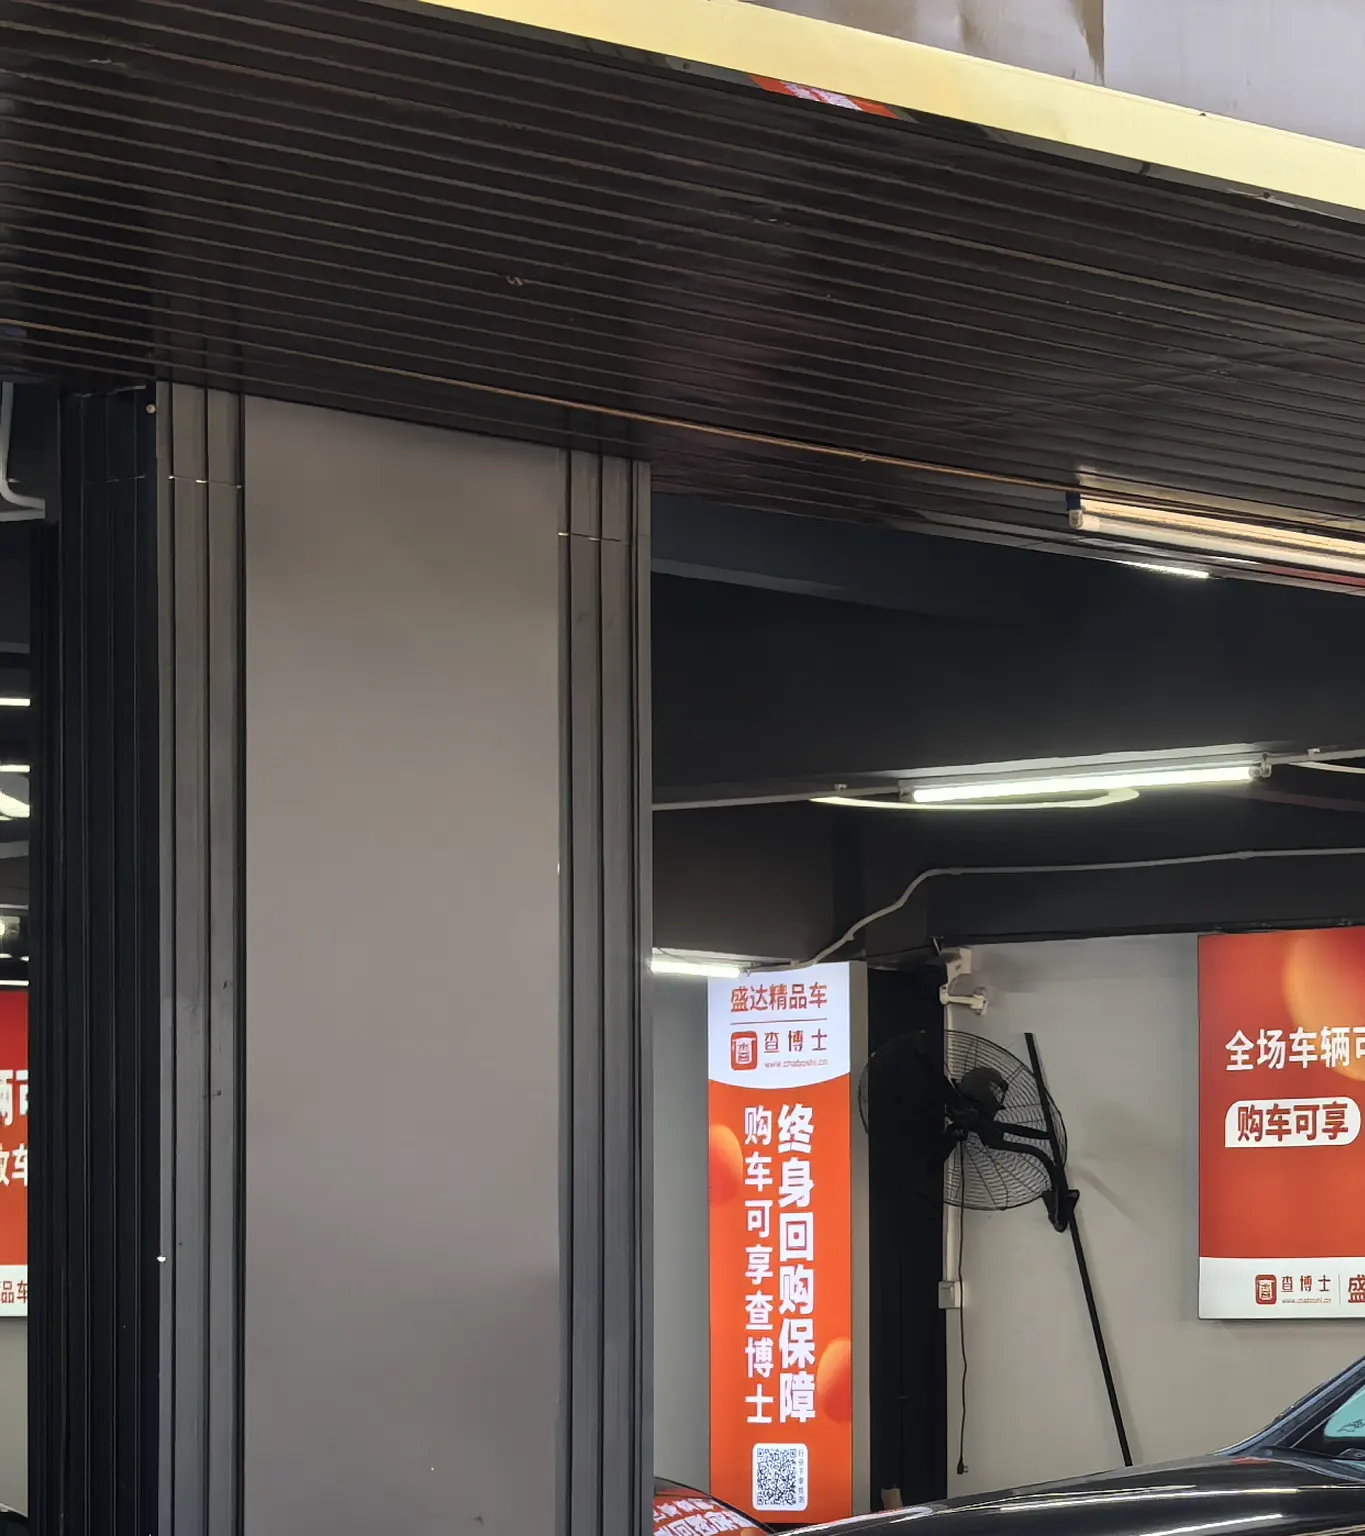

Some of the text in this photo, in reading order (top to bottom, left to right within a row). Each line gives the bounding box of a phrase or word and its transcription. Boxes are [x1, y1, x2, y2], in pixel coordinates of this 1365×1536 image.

[730, 982, 828, 1013] 盛达精品车
[764, 1029, 828, 1054] 查博士
[1236, 1101, 1349, 1143] 购车可享
[744, 1105, 774, 1424] 购车可享查博士
[778, 1103, 816, 1423] 终身回购保障
[1280, 1275, 1332, 1293] 查博士
